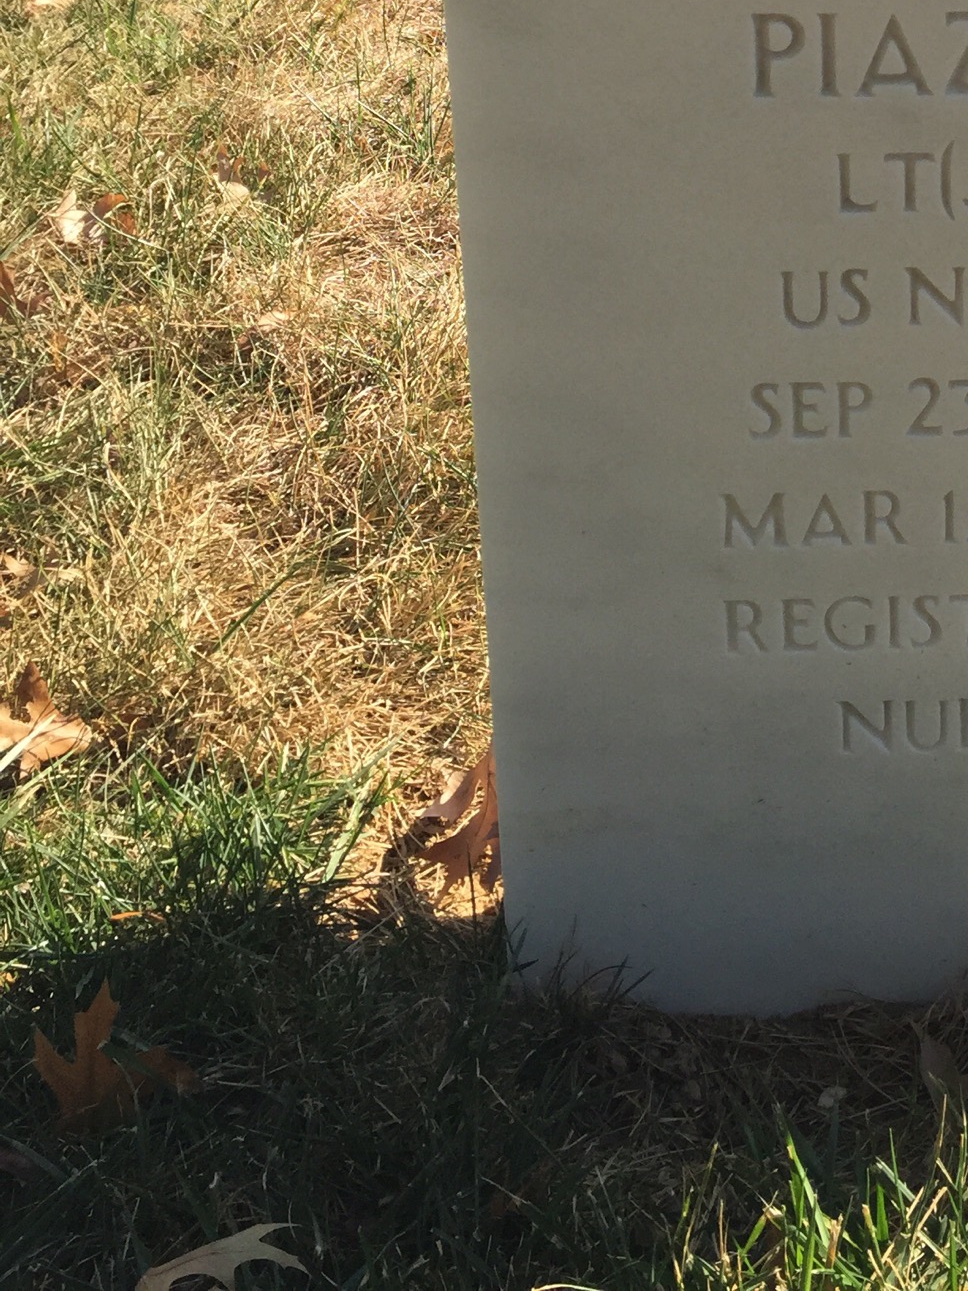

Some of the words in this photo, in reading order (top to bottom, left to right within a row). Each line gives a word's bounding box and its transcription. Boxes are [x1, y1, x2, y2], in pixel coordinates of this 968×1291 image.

[780, 267, 872, 329] US
[748, 380, 874, 440] SEP
[720, 489, 909, 548] MAR
